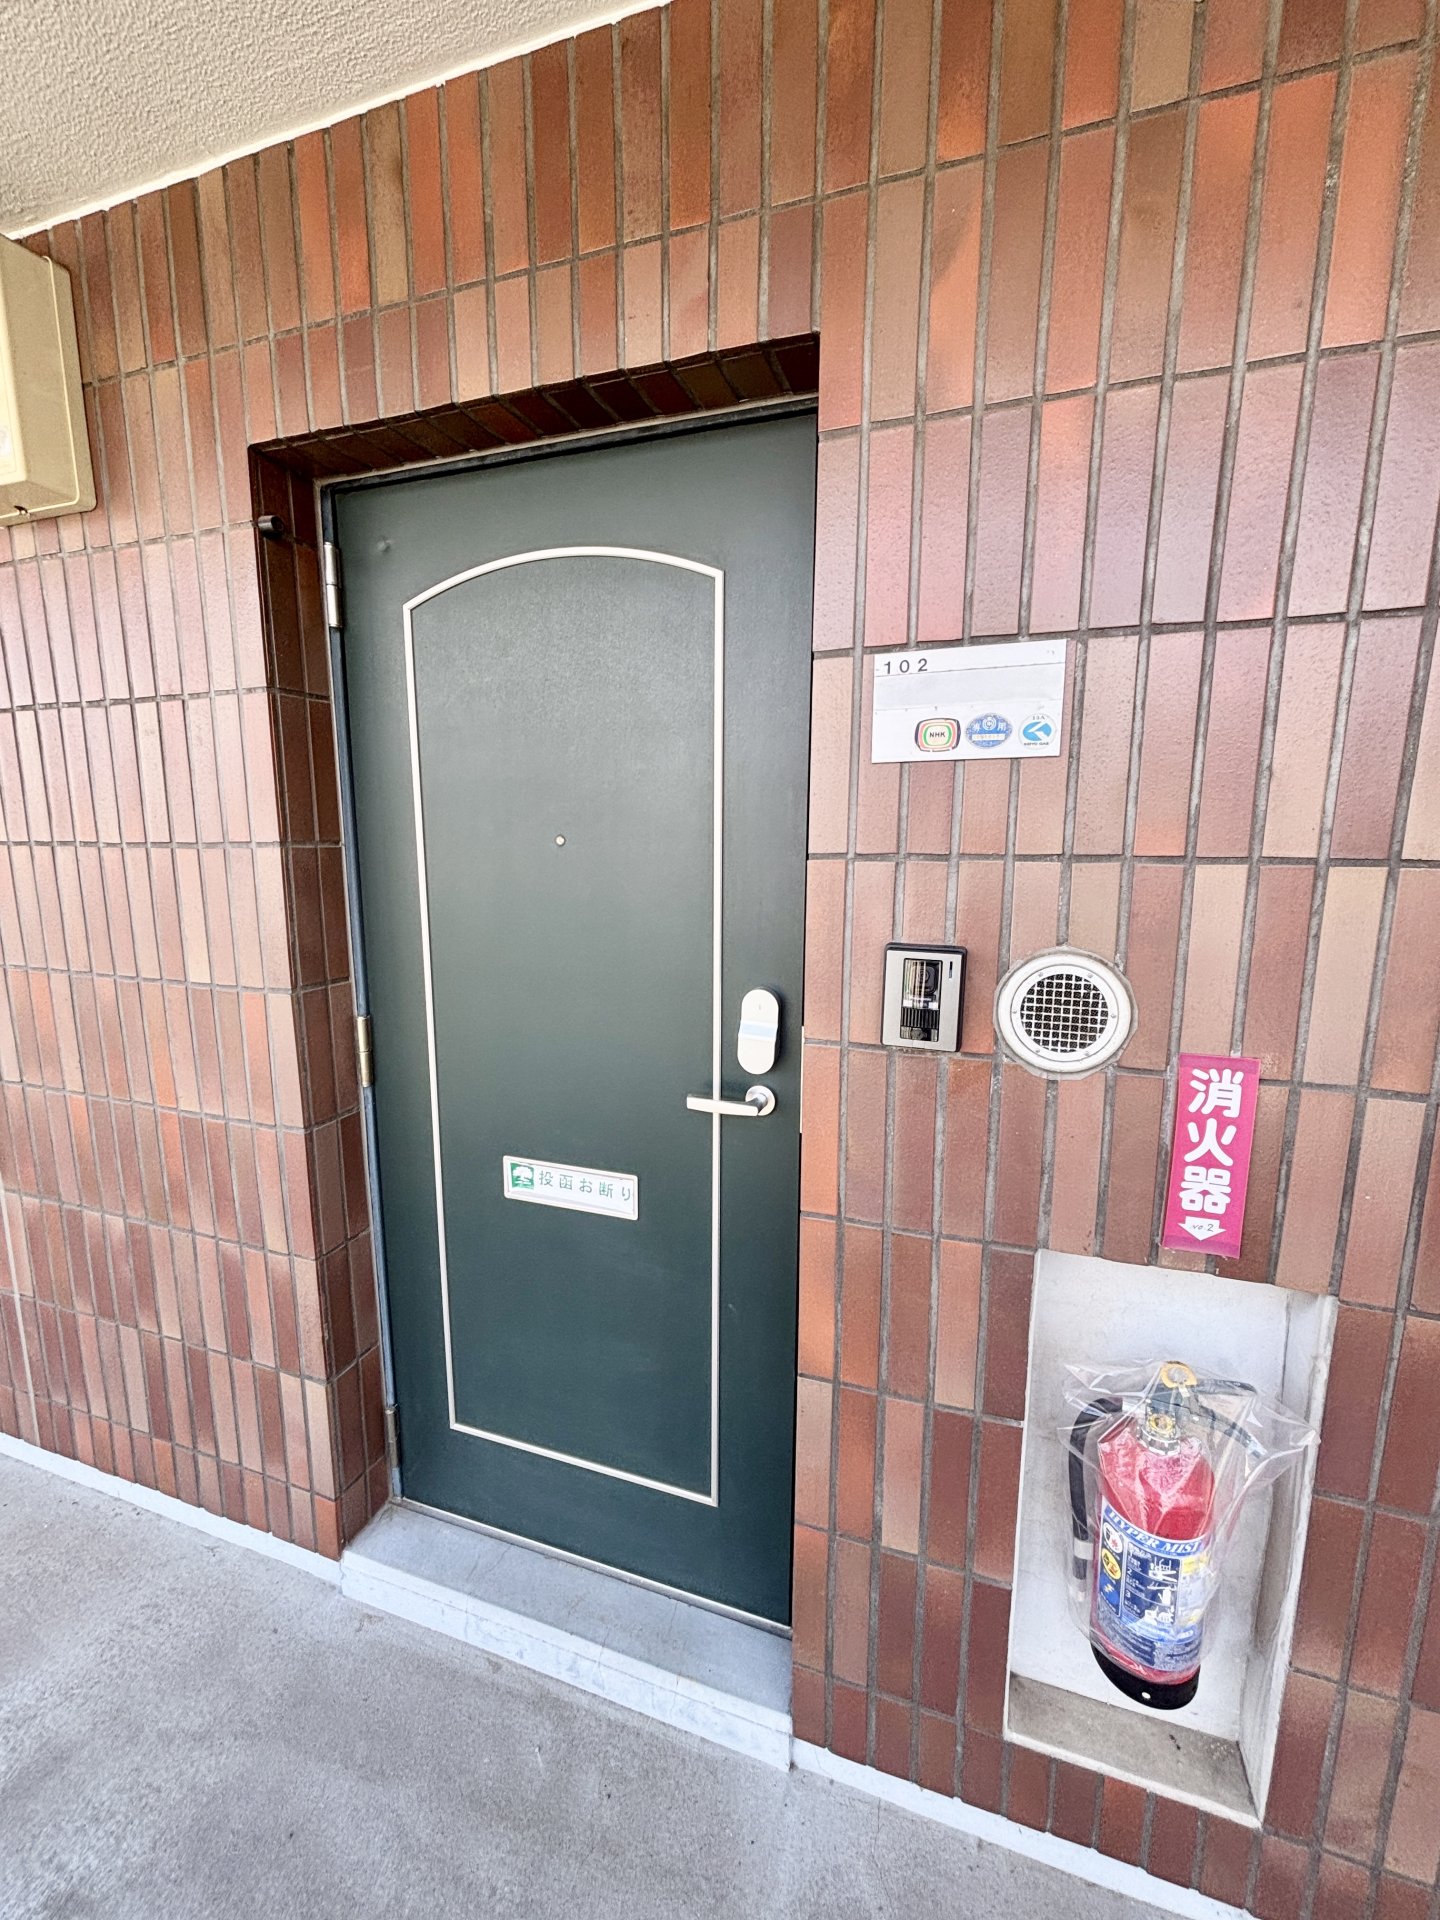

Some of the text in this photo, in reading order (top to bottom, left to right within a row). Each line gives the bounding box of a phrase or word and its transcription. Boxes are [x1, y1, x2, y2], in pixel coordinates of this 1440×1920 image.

[884, 658, 928, 675] 102
[929, 731, 946, 739] NHK
[1179, 1068, 1244, 1215] 消火器
[539, 1170, 631, 1201] 投函お断り
[1108, 1510, 1160, 1550] HYPER
[1160, 1540, 1201, 1554] MIST
